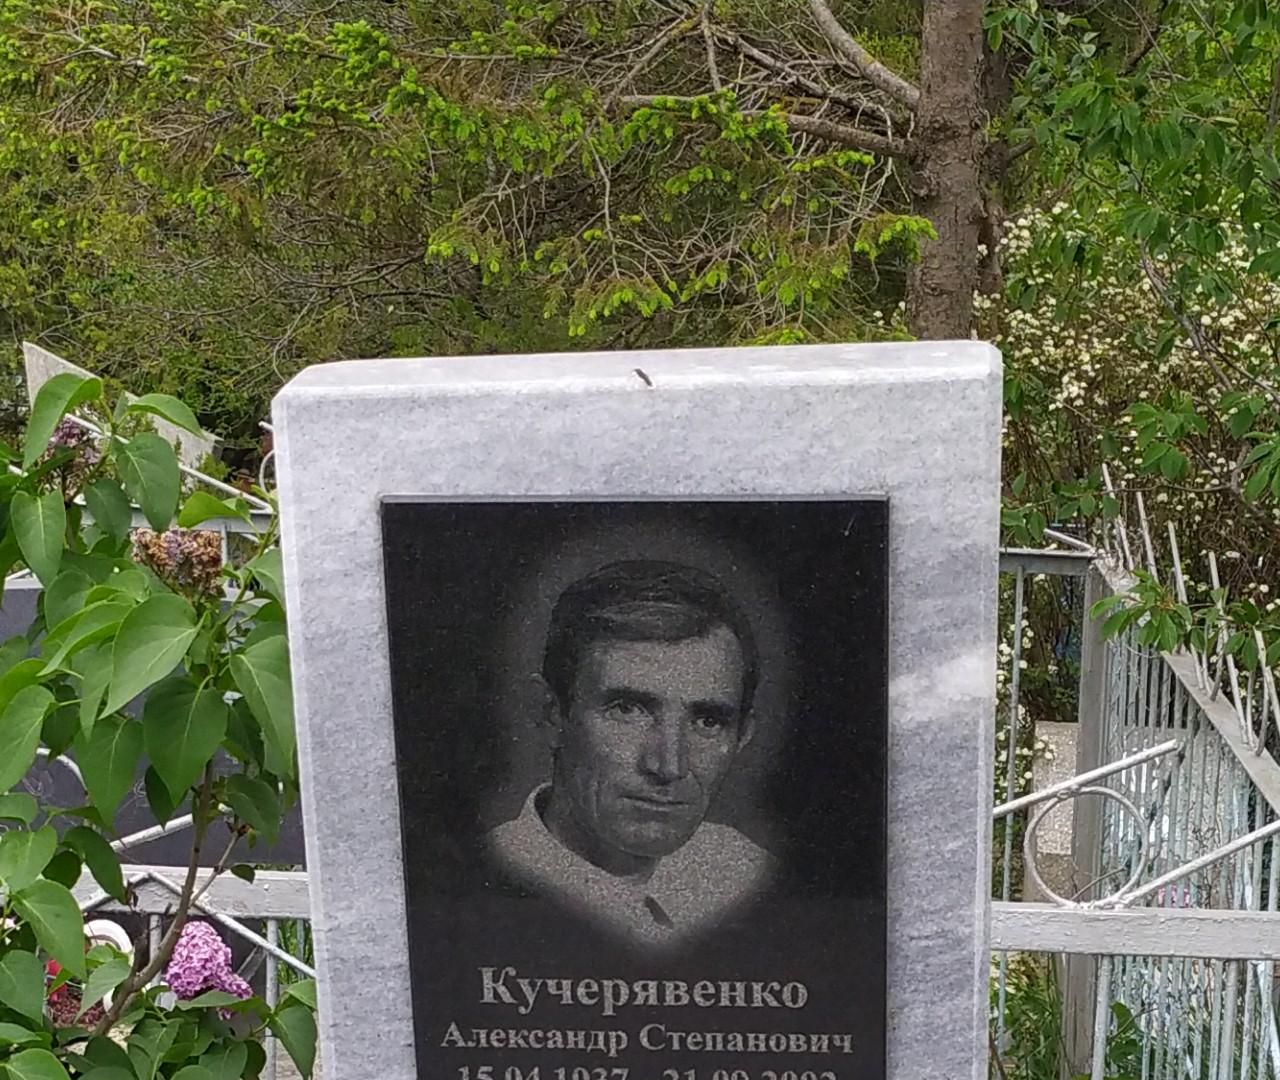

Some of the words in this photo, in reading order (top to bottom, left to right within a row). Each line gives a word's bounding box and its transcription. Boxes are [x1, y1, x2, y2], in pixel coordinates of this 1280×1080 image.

[478, 966, 809, 1016] Кучерявенко
[440, 1022, 629, 1058] Александр
[638, 1024, 854, 1054] Степанович
